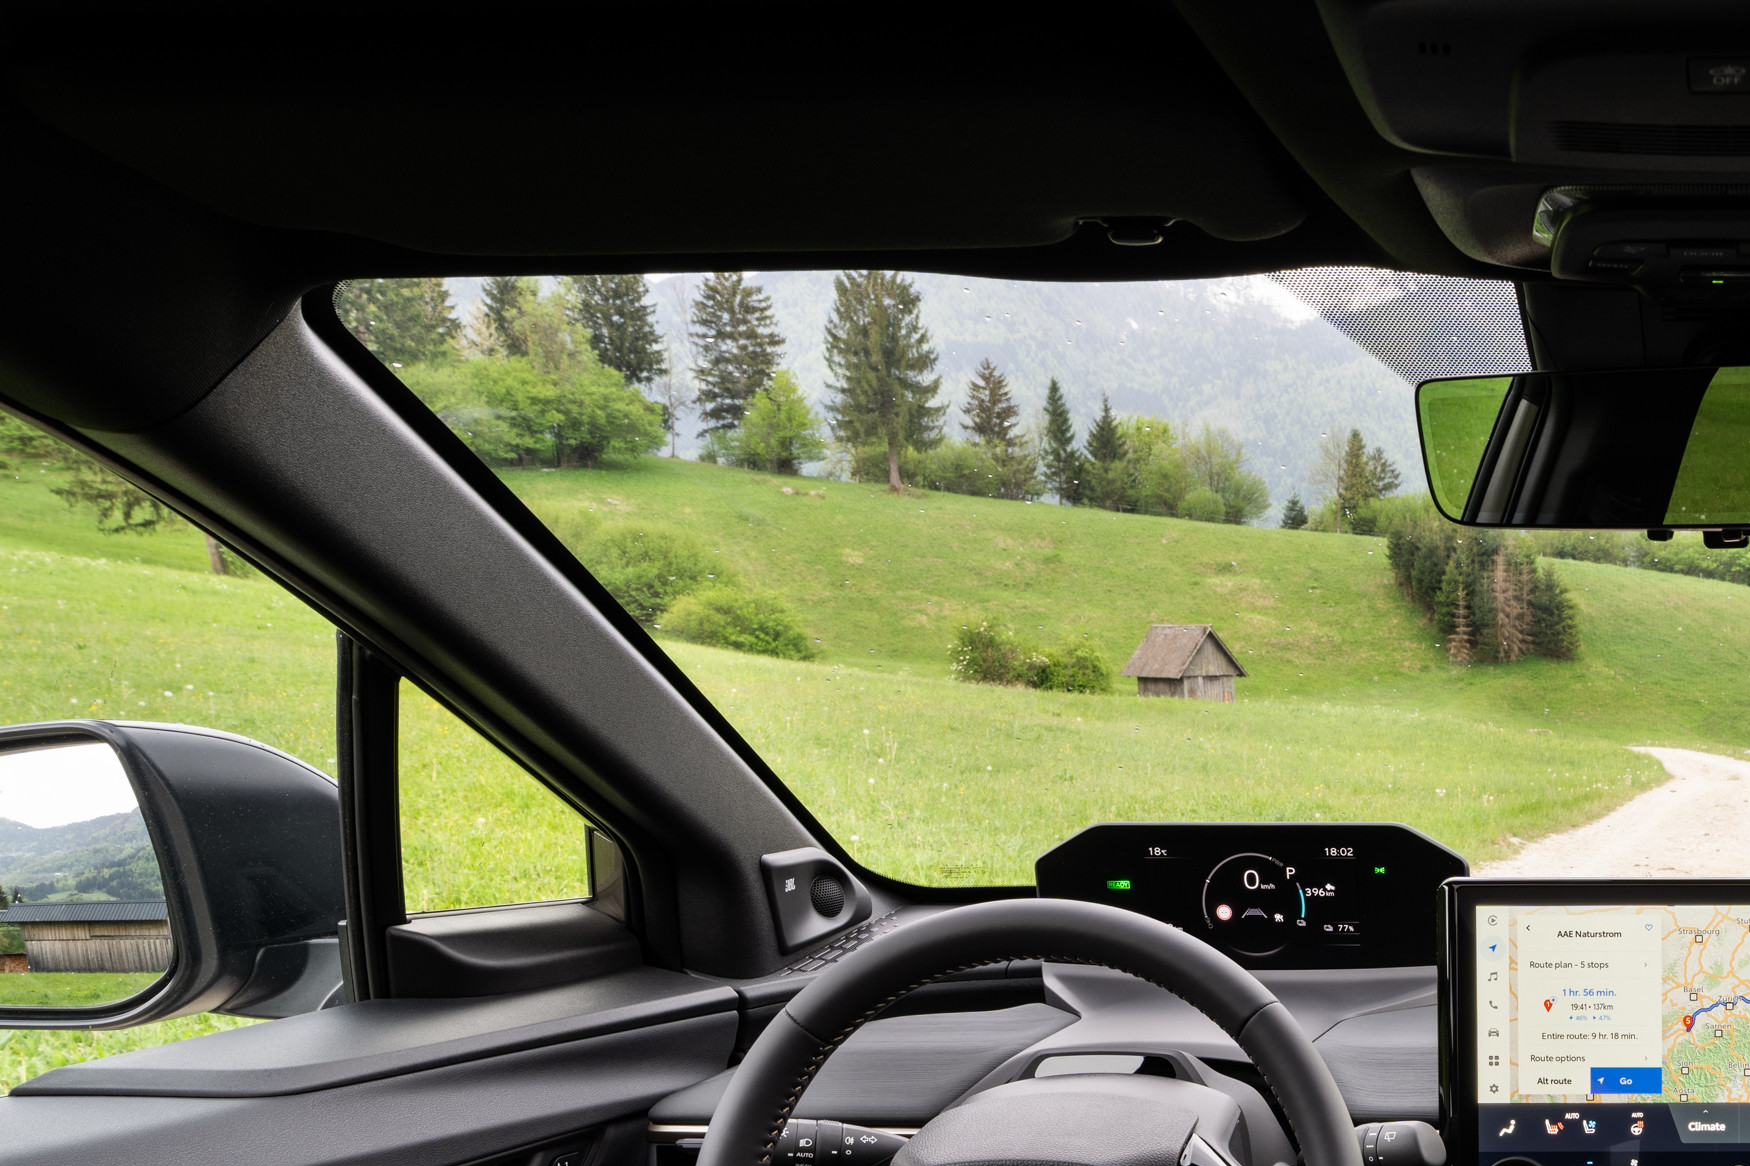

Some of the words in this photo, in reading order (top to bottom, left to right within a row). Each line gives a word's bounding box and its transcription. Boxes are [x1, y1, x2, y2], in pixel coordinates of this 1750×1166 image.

[1324, 847, 1354, 857] 18:02
[1286, 866, 1296, 880] P
[1243, 869, 1260, 890] 0
[1337, 924, 1355, 932] 77%
[1678, 928, 1720, 936] Strasbourg
[1557, 930, 1574, 938] AAE
[1575, 930, 1622, 938] Naturstrom
[1529, 961, 1553, 969] Route
[1554, 961, 1573, 971] plan
[1580, 961, 1586, 969] 5
[1587, 961, 1609, 971] stops
[1568, 988, 1581, 997] hr.
[1583, 988, 1595, 997] 56
[1596, 988, 1617, 997] min.
[1541, 1032, 1565, 1040] Entire
[1566, 1032, 1590, 1040] route:
[1591, 1032, 1597, 1040] 9
[1598, 1032, 1609, 1040] hr.
[1610, 1032, 1620, 1040] 18
[1621, 1032, 1639, 1040] min.
[1530, 1055, 1553, 1063] Route
[1555, 1055, 1586, 1063] options
[1677, 1060, 1694, 1068] Sion
[1537, 1077, 1549, 1085] Alt
[1551, 1077, 1573, 1085] route
[1619, 1077, 1633, 1085] Go
[1688, 1121, 1726, 1132] Climate
